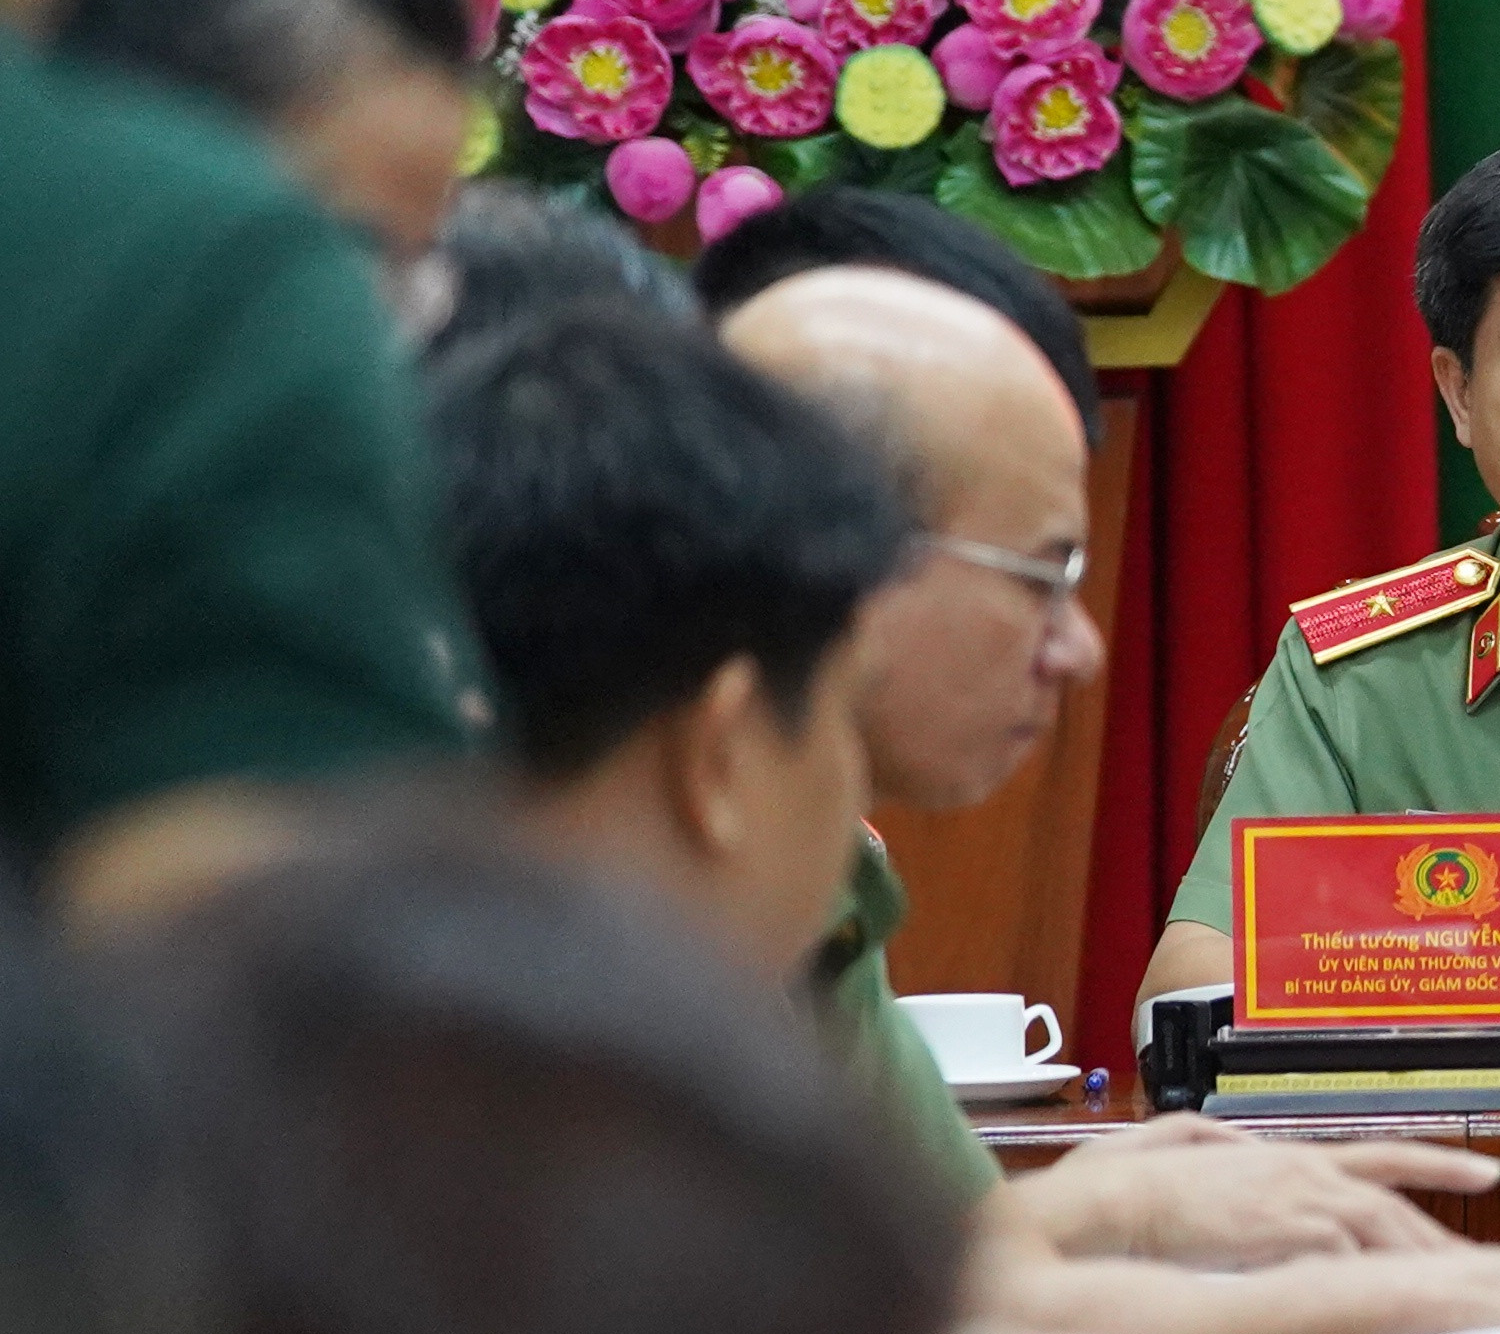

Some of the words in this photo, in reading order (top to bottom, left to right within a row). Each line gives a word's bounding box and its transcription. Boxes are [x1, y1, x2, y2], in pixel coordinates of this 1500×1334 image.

[1301, 930, 1353, 950] Thiếu
[1361, 930, 1419, 951] tướng
[1318, 954, 1339, 973] ỦY
[1343, 953, 1379, 972] VIÊN
[1382, 956, 1415, 971] BAN
[1421, 951, 1488, 971] THƯỜNG
[1285, 975, 1300, 995] BÍ
[1303, 976, 1338, 994] THƯ
[1340, 974, 1386, 994] ĐẢNG
[1389, 974, 1415, 995] ỦY,
[1418, 972, 1461, 992] GIÁM
[1465, 970, 1498, 991] ĐỐC
